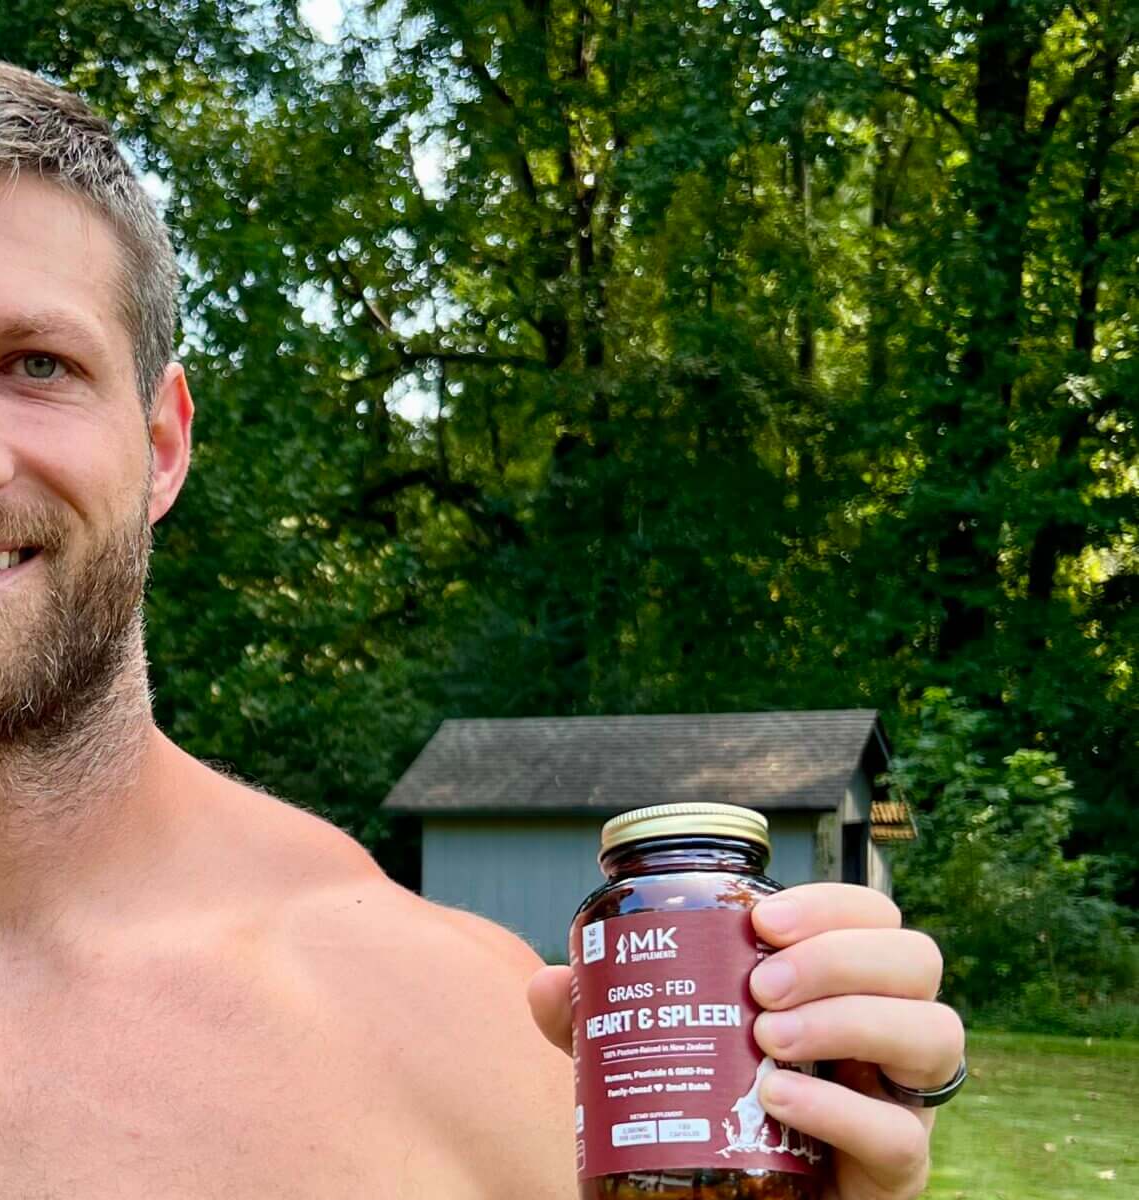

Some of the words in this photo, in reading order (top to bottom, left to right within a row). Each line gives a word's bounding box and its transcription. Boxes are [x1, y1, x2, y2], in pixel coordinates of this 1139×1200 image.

[629, 926, 679, 953] MK
[630, 949, 677, 962] SUPPLEMENTS
[608, 982, 653, 1003] GRASS
[665, 979, 696, 996] FED
[586, 1009, 634, 1039] HEART
[637, 1007, 655, 1030] &
[657, 1003, 741, 1028] SPLEEN
[686, 1042, 715, 1051] Zealand
[665, 1082, 688, 1092] Small
